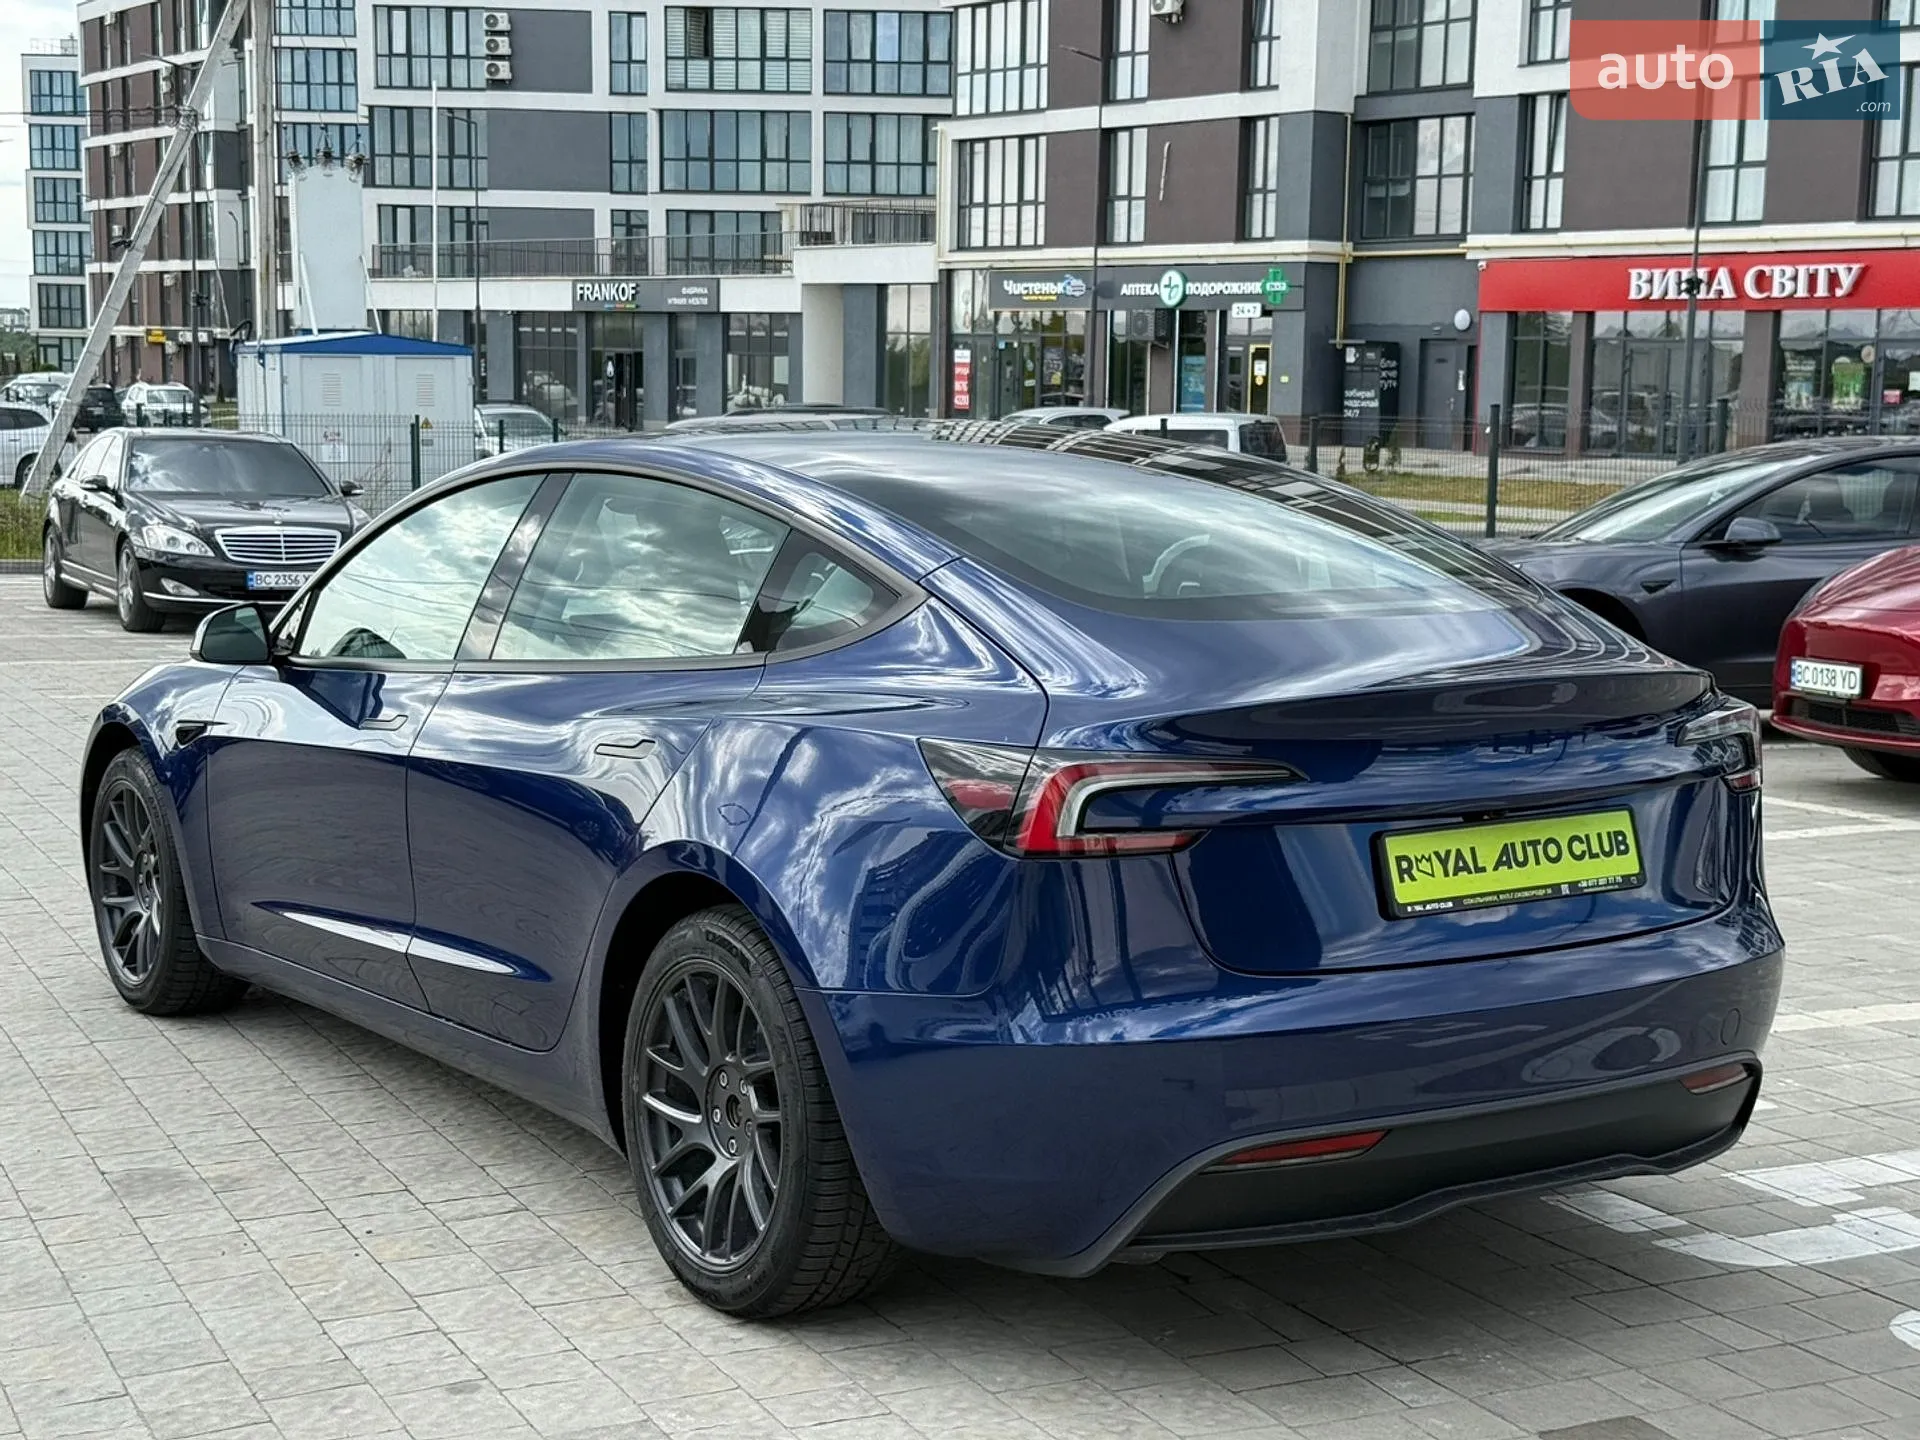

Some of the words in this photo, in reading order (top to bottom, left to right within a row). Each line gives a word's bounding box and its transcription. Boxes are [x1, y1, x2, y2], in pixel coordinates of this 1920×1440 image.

[1120, 283, 1160, 296] АПТЕКА
[1185, 280, 1263, 297] ПОДОРОЖНИК
[1744, 263, 1865, 298] СВІТУ
[576, 283, 637, 301] FRANKOF
[1812, 667, 1837, 687] 0138
[1840, 669, 1857, 689] YD
[1492, 837, 1563, 871] AUTO
[1567, 830, 1630, 861] CLUB
